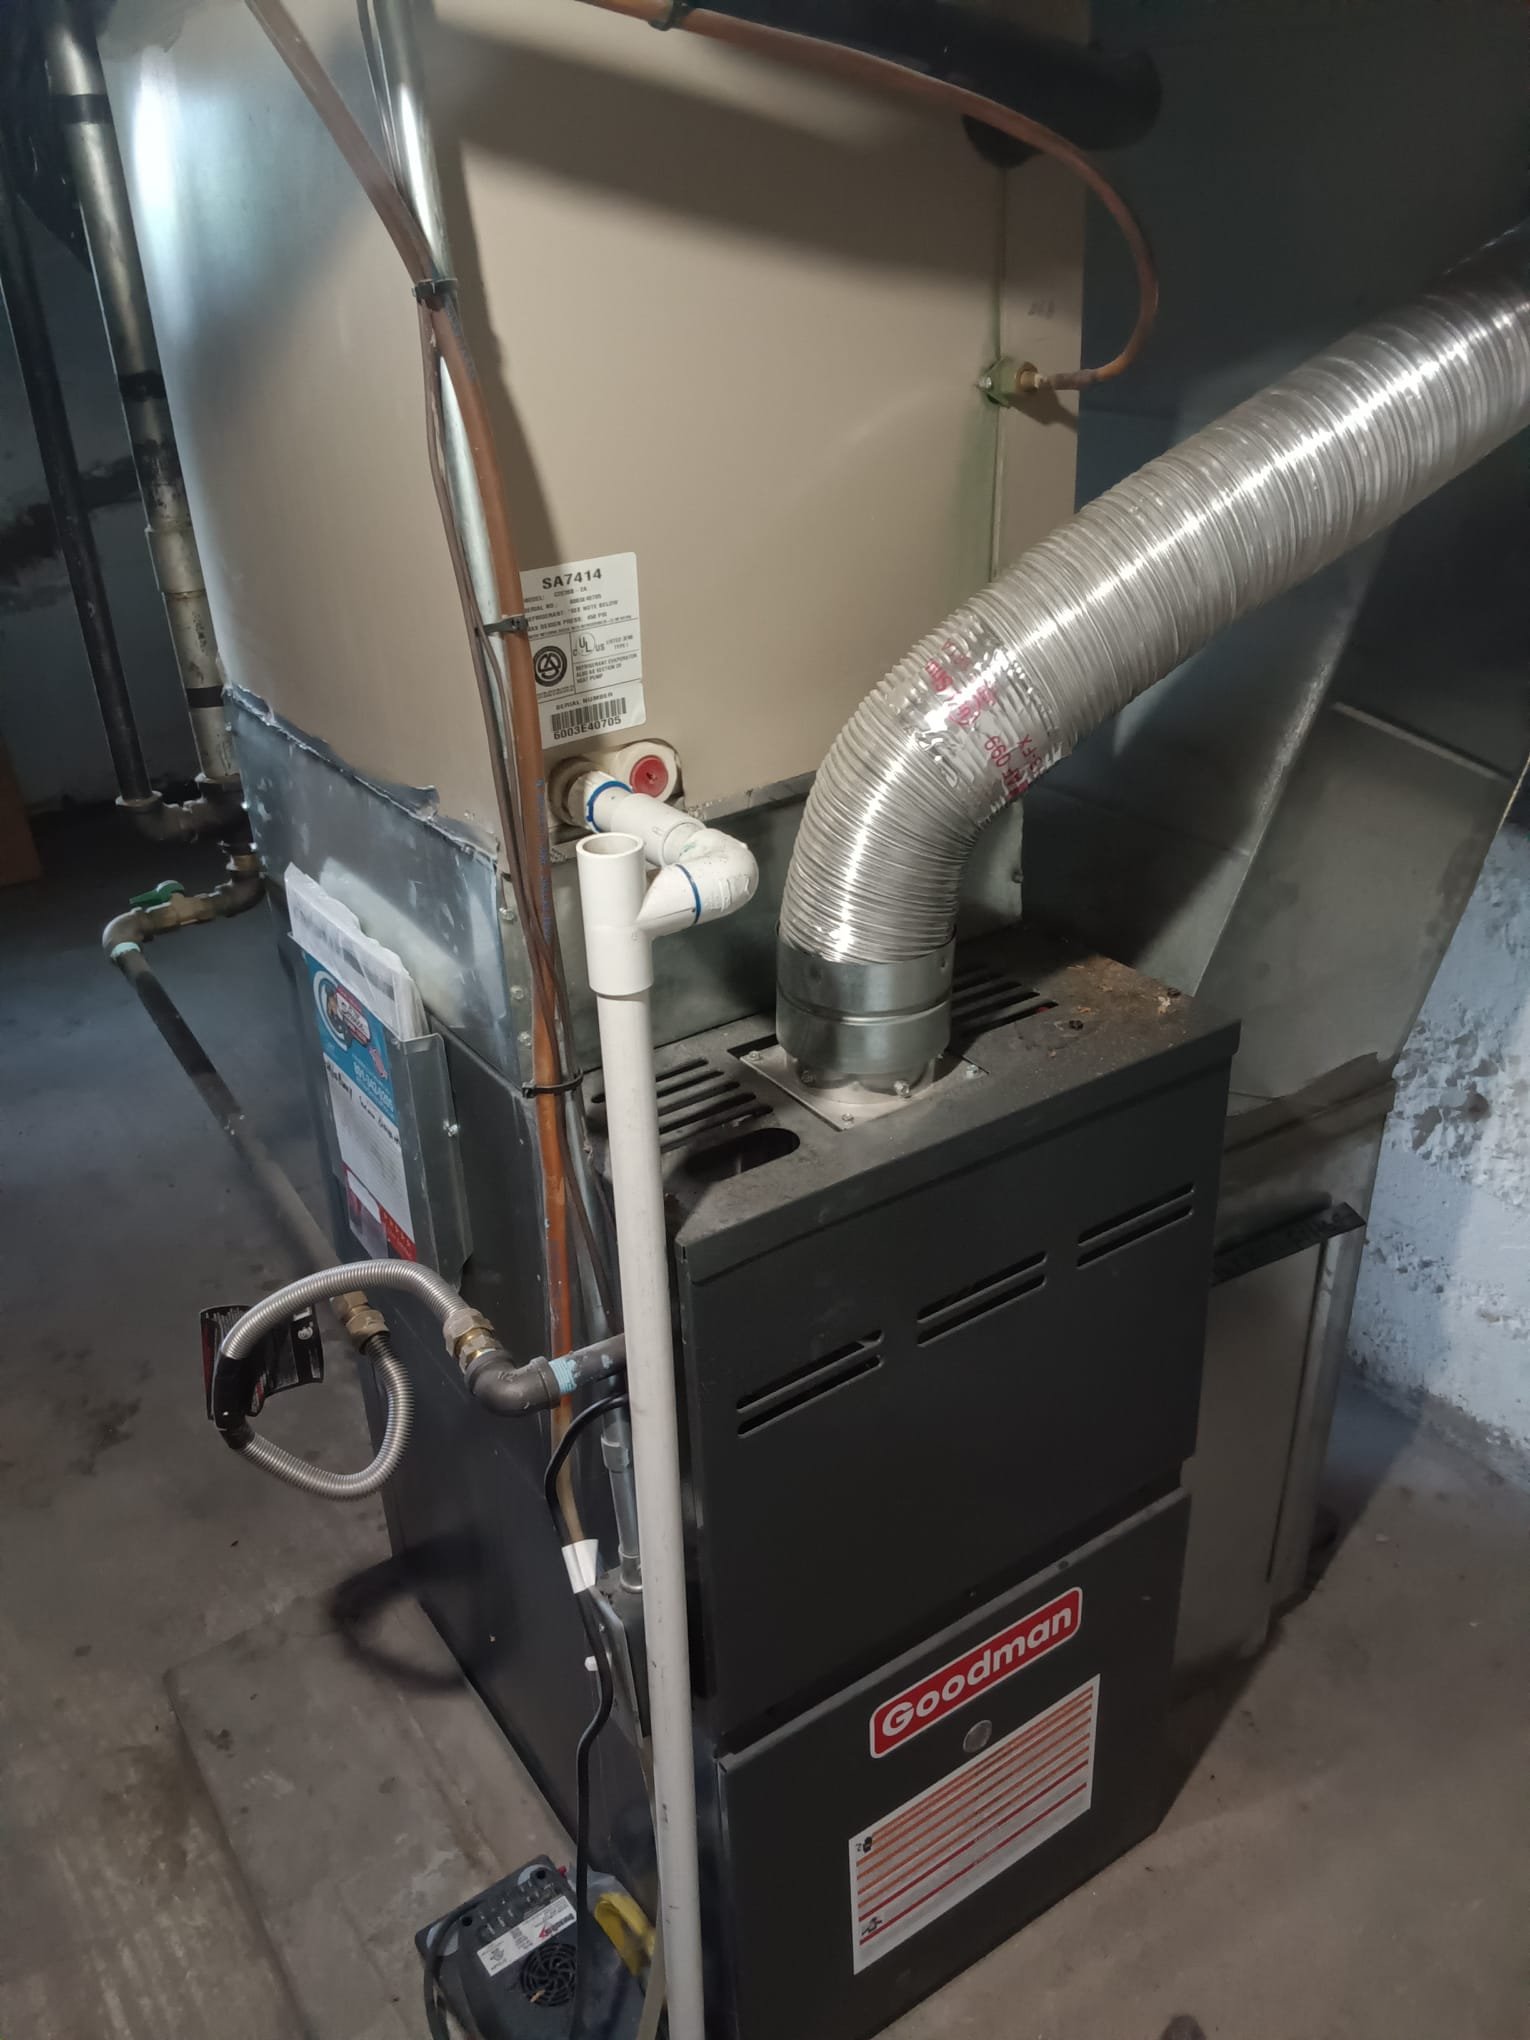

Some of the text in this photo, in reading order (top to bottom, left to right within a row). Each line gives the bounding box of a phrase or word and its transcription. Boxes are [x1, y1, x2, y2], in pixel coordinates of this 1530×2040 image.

[542, 568, 602, 590] SA7414
[589, 672, 604, 681] PUMP
[555, 692, 613, 710] SERIAL NUMBER
[553, 715, 622, 740] 6003E40705
[882, 1607, 1072, 1737] Goodman
